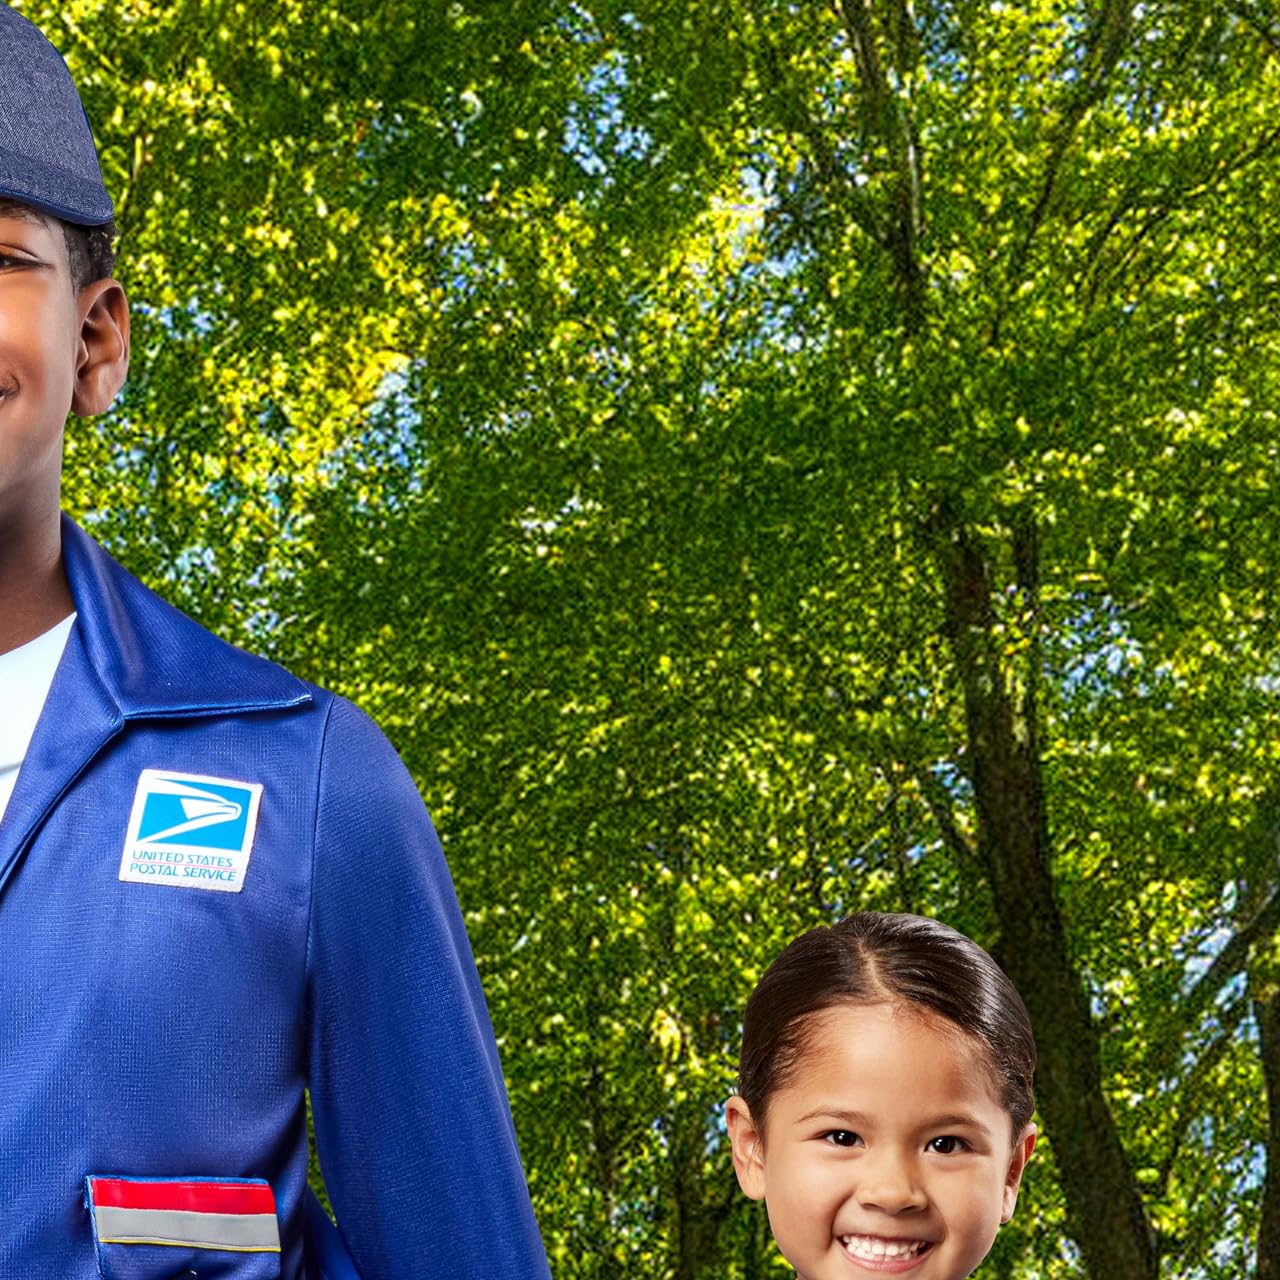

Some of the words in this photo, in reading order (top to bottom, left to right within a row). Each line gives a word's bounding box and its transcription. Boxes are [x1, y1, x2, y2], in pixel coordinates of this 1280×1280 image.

[132, 850, 184, 863] UNITED
[186, 854, 233, 867] STATES
[130, 863, 179, 876] POSTAL
[182, 867, 237, 881] SERVICE
